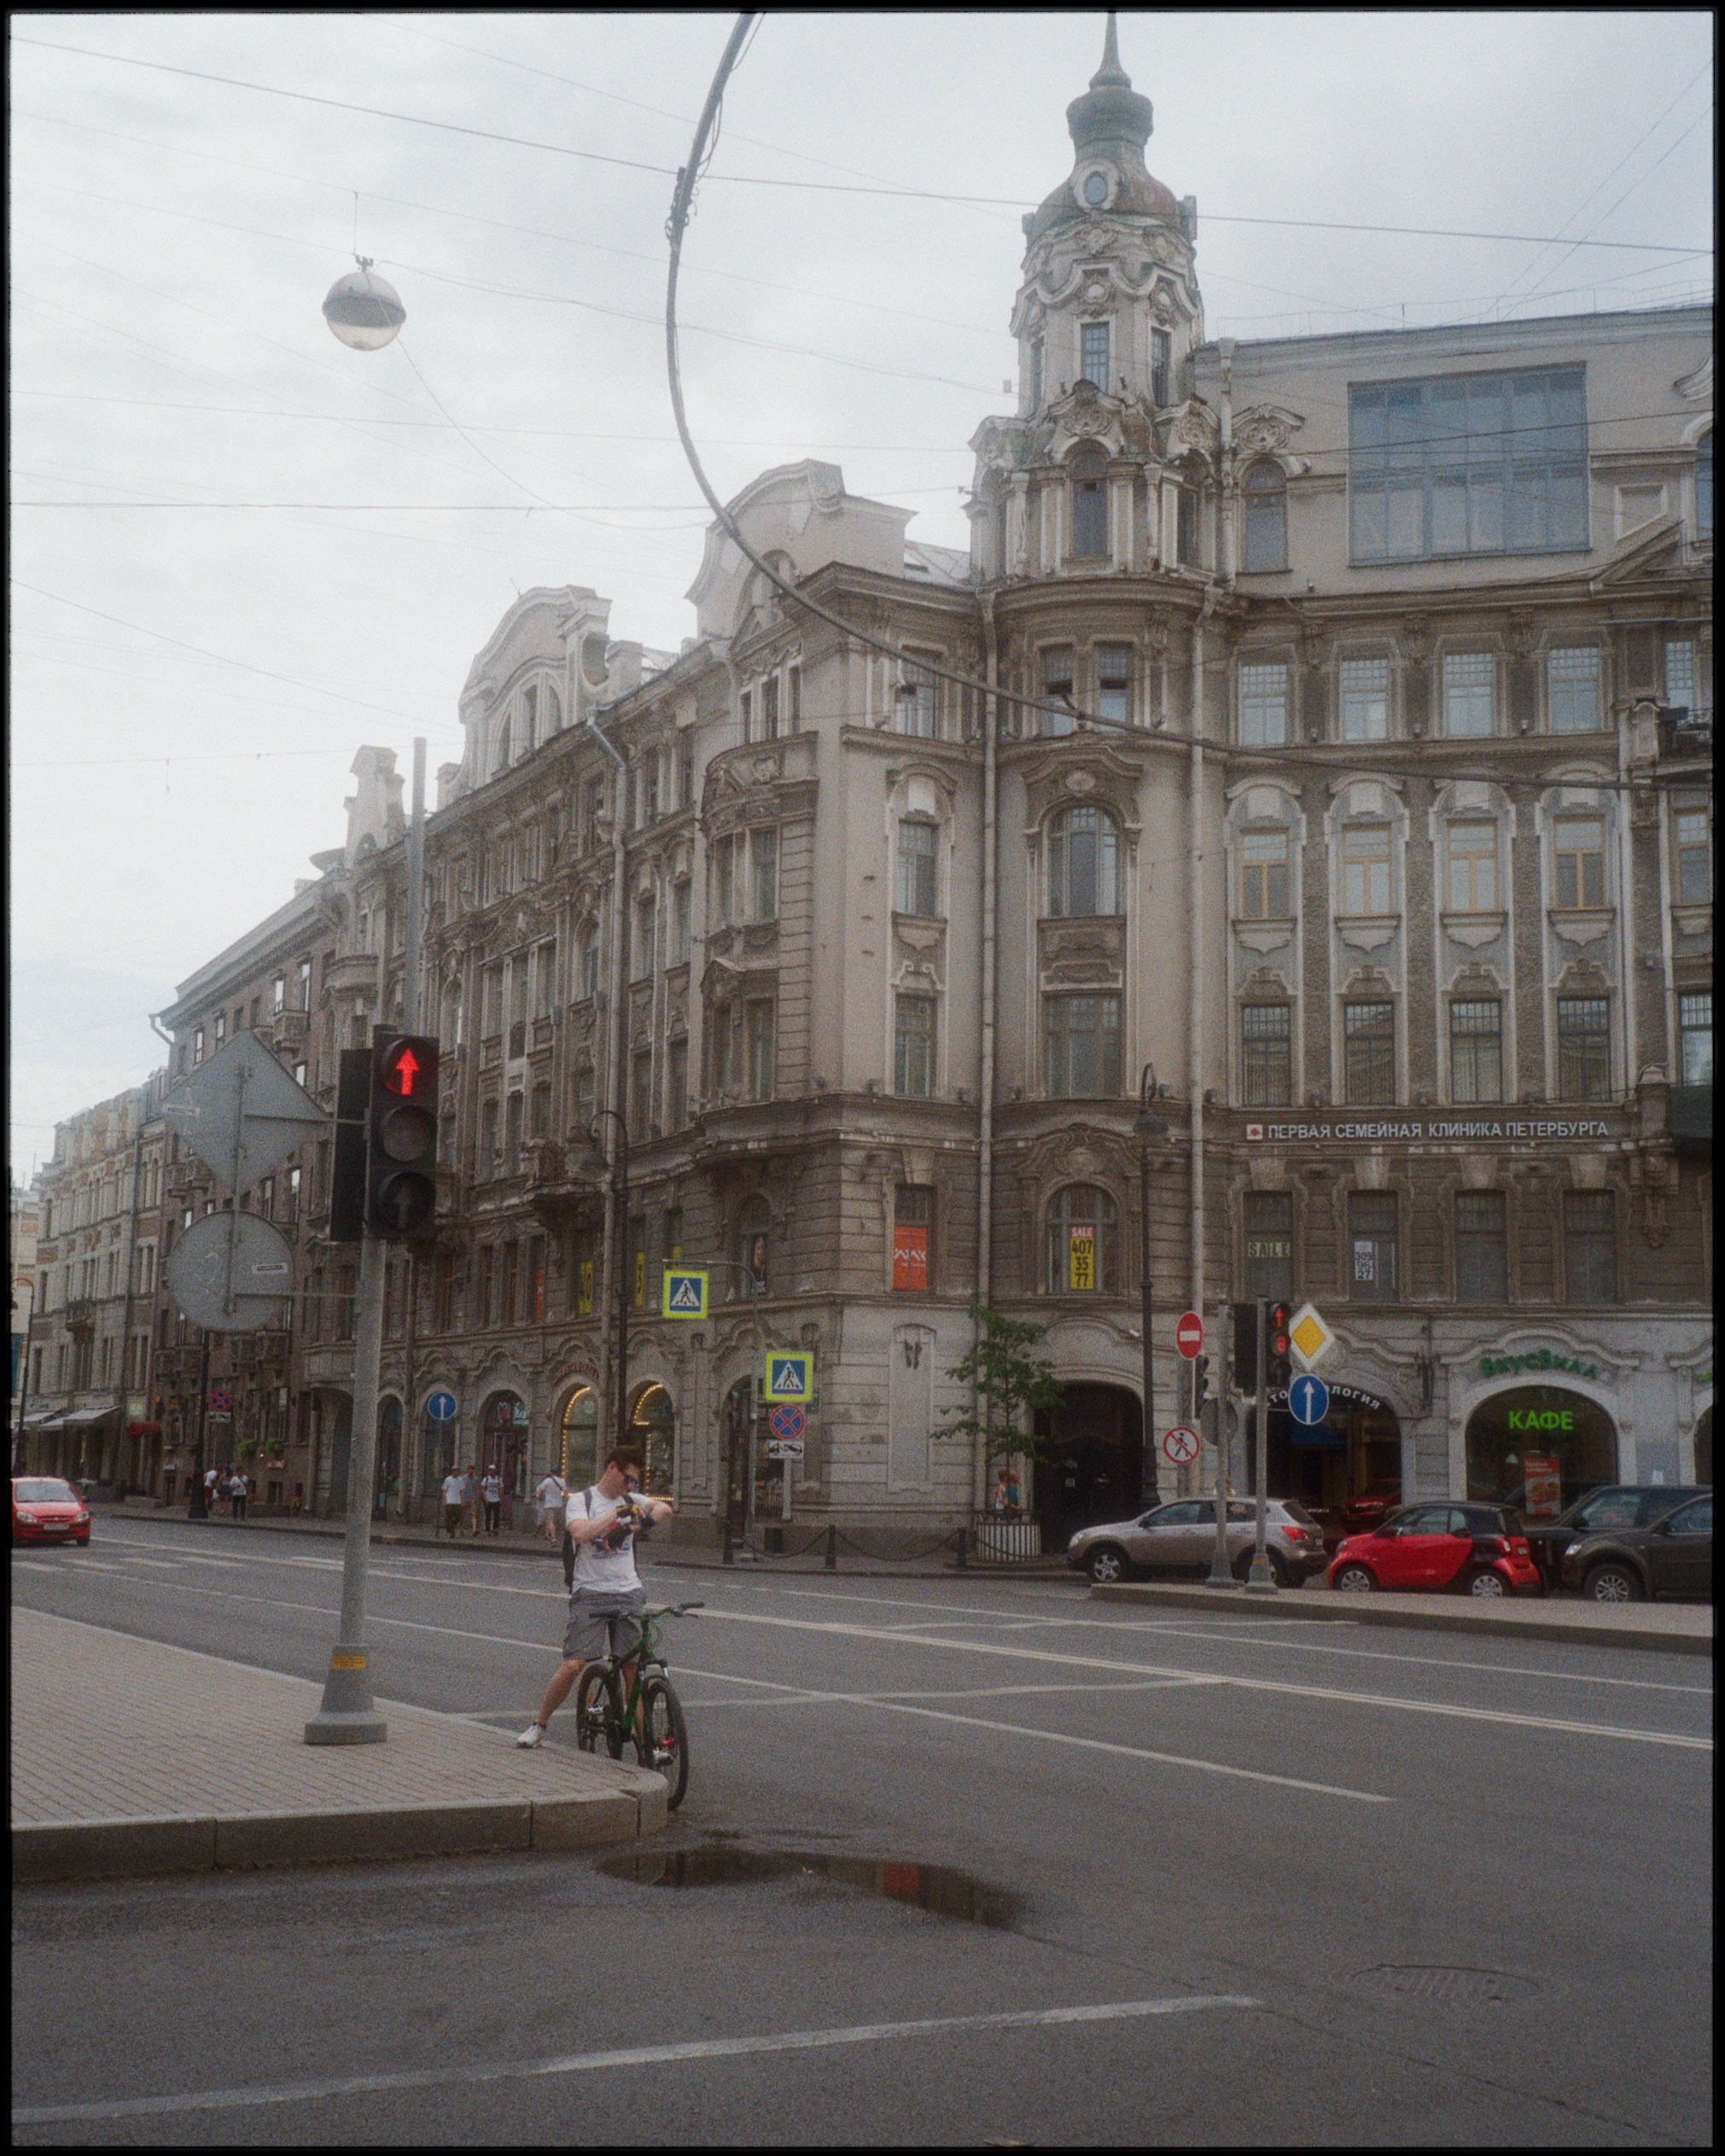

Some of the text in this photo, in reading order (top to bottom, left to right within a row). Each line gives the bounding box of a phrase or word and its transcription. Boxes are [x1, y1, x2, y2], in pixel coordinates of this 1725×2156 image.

[1268, 1121, 1608, 1139] ПЕРВАЯ СЕМЕЙНАЯ КЛИНИКА ПЕТЕРБУРГА
[1071, 1227, 1093, 1237] SALE
[1072, 1239, 1093, 1255] 407
[1248, 1242, 1291, 1257] SALE
[1075, 1256, 1089, 1271] 35
[1075, 1272, 1088, 1287] 77
[1508, 1410, 1574, 1431] КАФЕ
